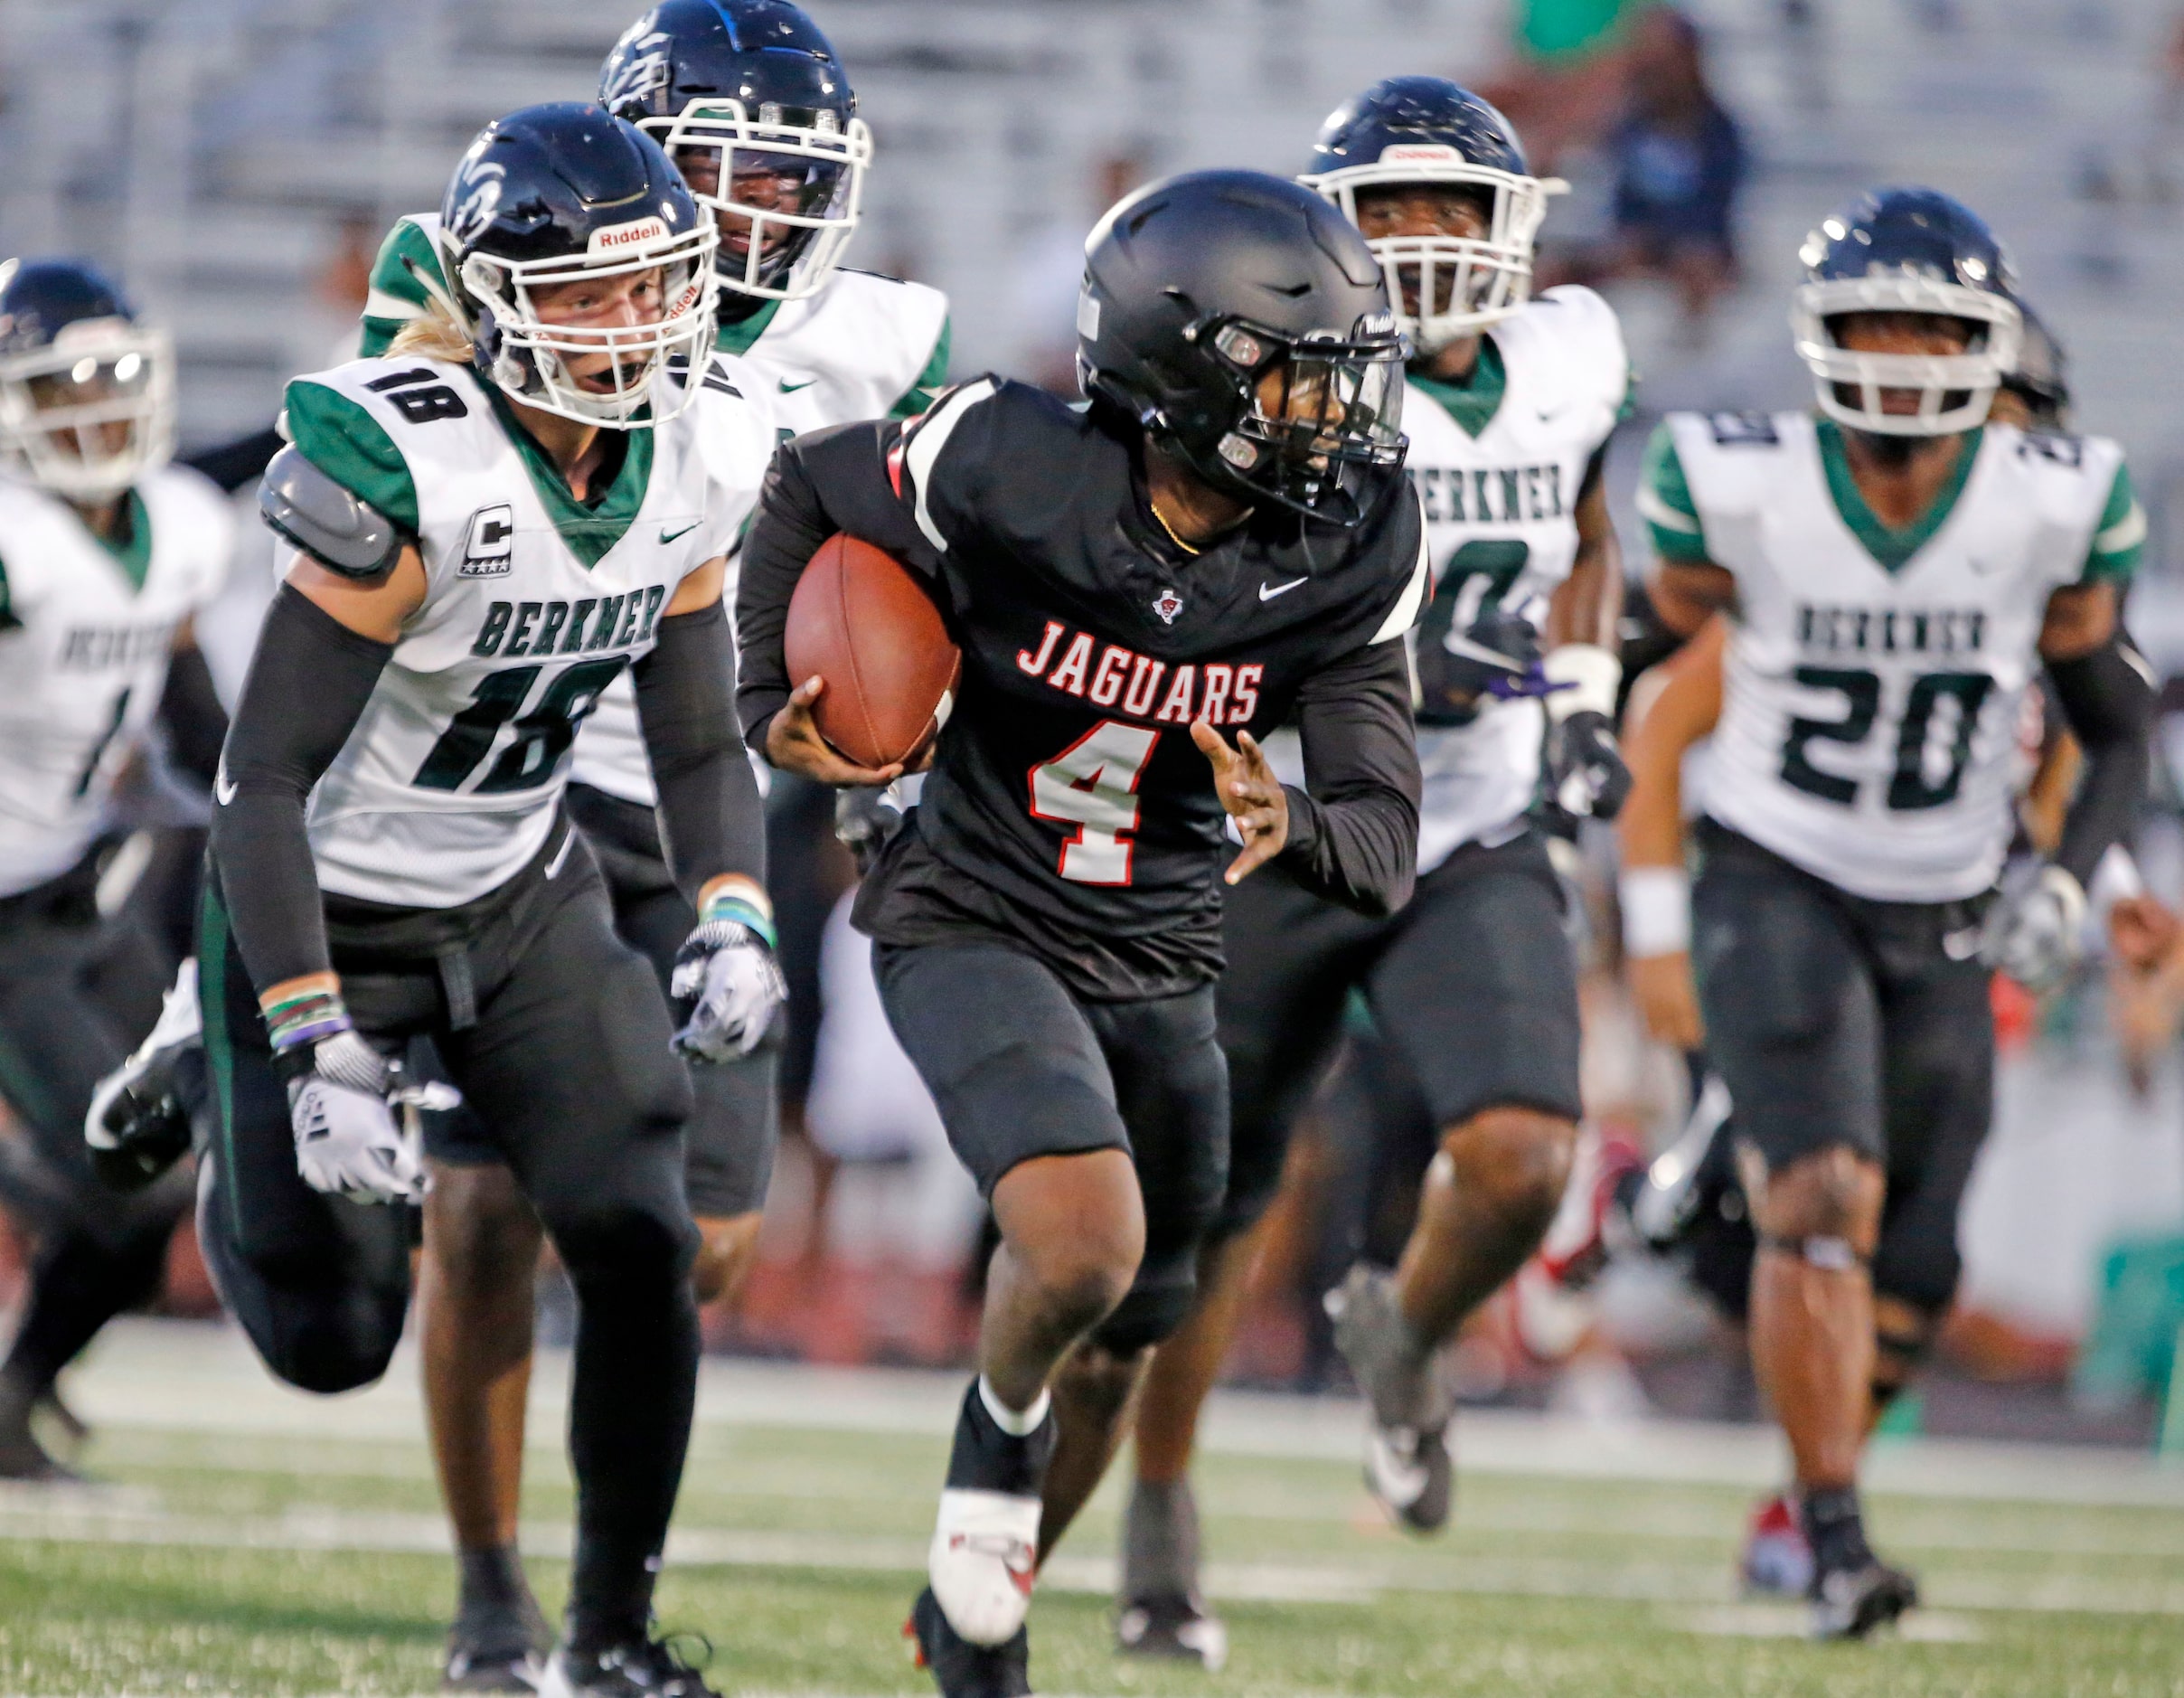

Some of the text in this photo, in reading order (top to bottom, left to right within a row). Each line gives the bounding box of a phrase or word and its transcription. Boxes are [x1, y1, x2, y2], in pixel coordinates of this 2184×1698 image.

[599, 224, 662, 248] Riddell
[360, 368, 468, 425] 18
[466, 505, 513, 560] C
[470, 584, 665, 657] BERKNER
[1016, 620, 1265, 724] JAGUARS
[411, 654, 631, 795] 18
[1781, 666, 1995, 810] 20
[1027, 718, 1163, 888] 4
